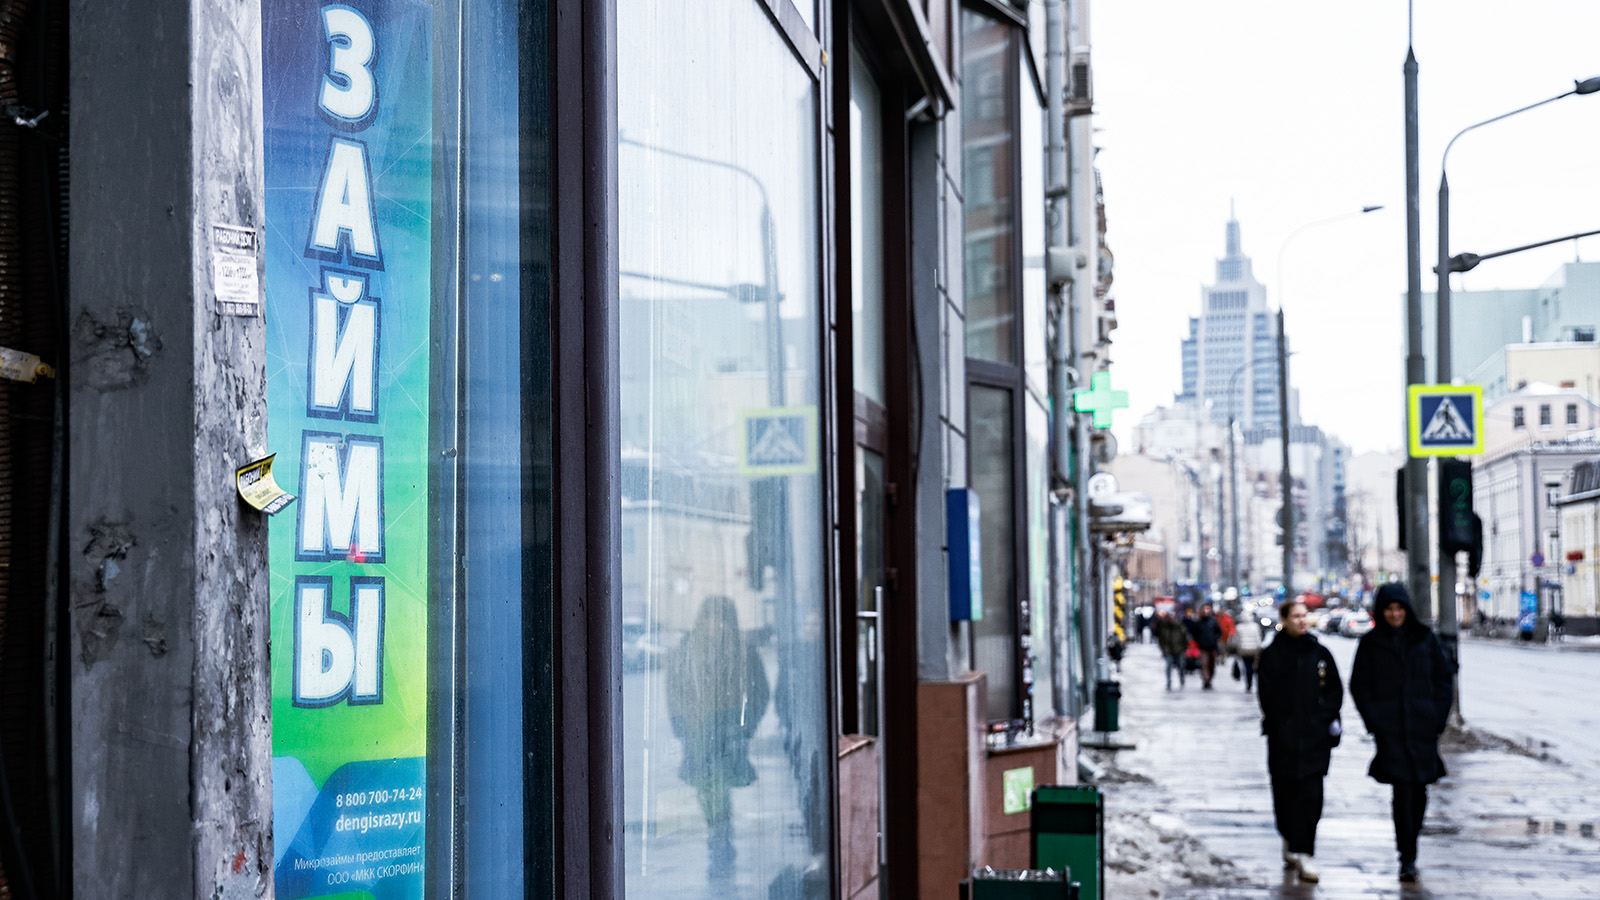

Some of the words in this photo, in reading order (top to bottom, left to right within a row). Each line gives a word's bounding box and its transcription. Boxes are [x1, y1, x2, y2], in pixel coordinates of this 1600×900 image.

[293, 4, 385, 707] ЗАЙМЫ
[336, 794, 343, 807] 8
[345, 792, 366, 807] 800
[368, 786, 422, 805] 700-74-24
[335, 810, 421, 834] dengisrazy.ru
[294, 853, 354, 871] Микрозаймы
[356, 845, 421, 865] предоставляет
[327, 871, 350, 886] ООО
[351, 866, 376, 882] «МКК
